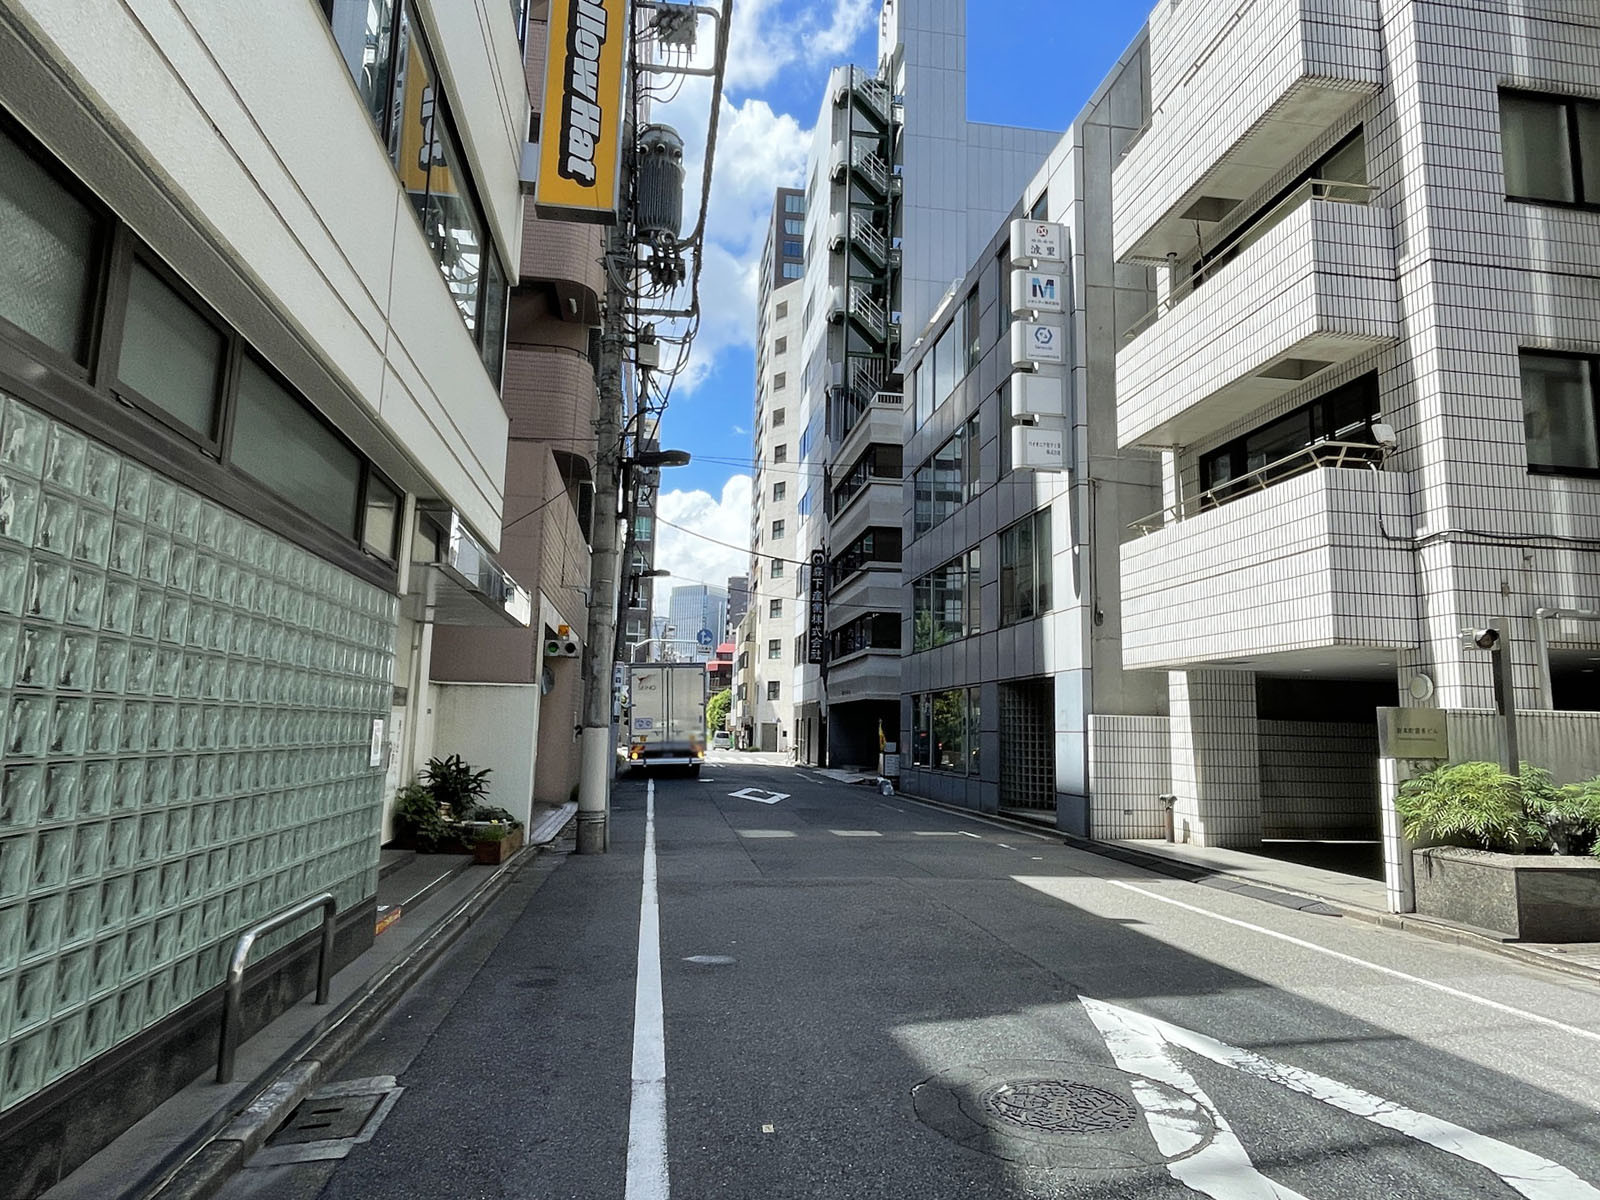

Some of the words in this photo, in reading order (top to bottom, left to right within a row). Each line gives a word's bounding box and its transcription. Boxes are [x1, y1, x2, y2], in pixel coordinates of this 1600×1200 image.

[1030, 244, 1055, 256] 波里
[810, 567, 824, 660] 森下産業株式会社
